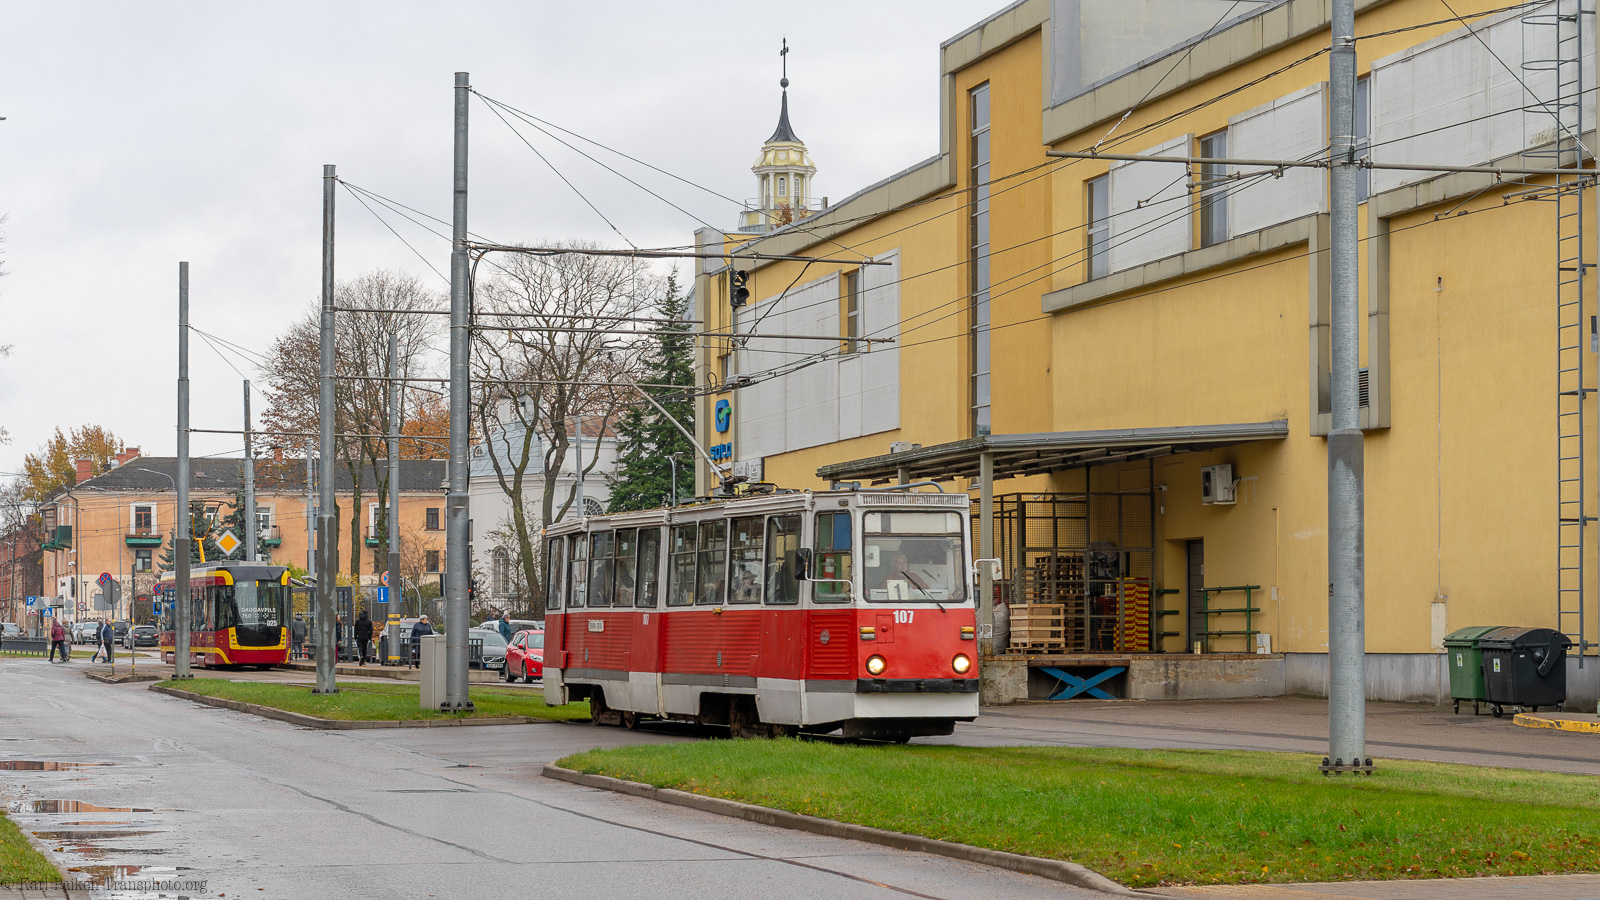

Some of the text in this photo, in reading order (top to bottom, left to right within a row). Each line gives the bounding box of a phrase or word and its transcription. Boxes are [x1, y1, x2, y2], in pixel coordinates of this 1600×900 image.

[710, 442, 732, 460] SOLO
[894, 583, 902, 600] 1
[266, 619, 278, 627] 025
[893, 609, 914, 624] 107
